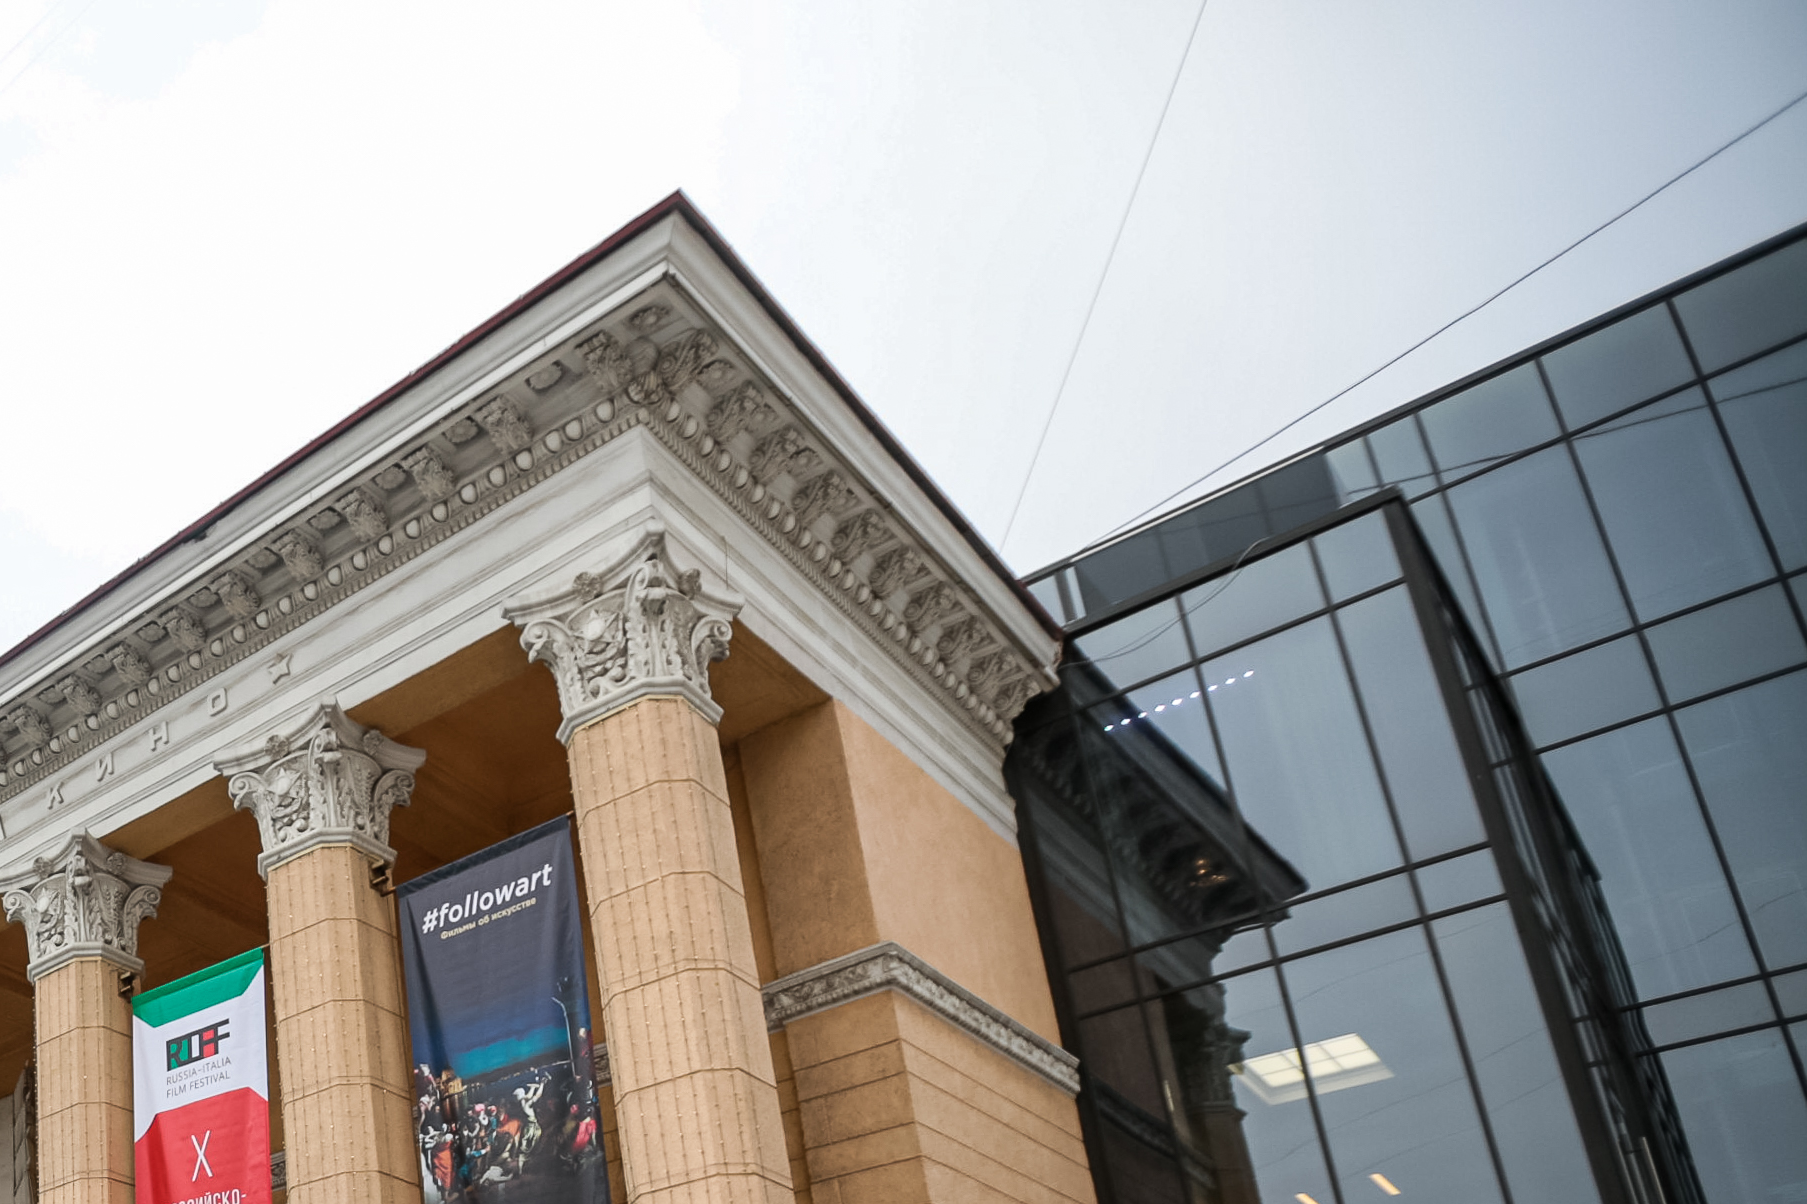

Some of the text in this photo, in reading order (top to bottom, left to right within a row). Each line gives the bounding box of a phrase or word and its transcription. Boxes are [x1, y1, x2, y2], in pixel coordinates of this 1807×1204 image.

[48, 687, 228, 810] КИНО
[422, 863, 553, 934] #followart
[440, 897, 536, 939] Фильмы об искусстве
[166, 1070, 231, 1098] FILM FESTIVAL
[191, 1130, 213, 1182] X
